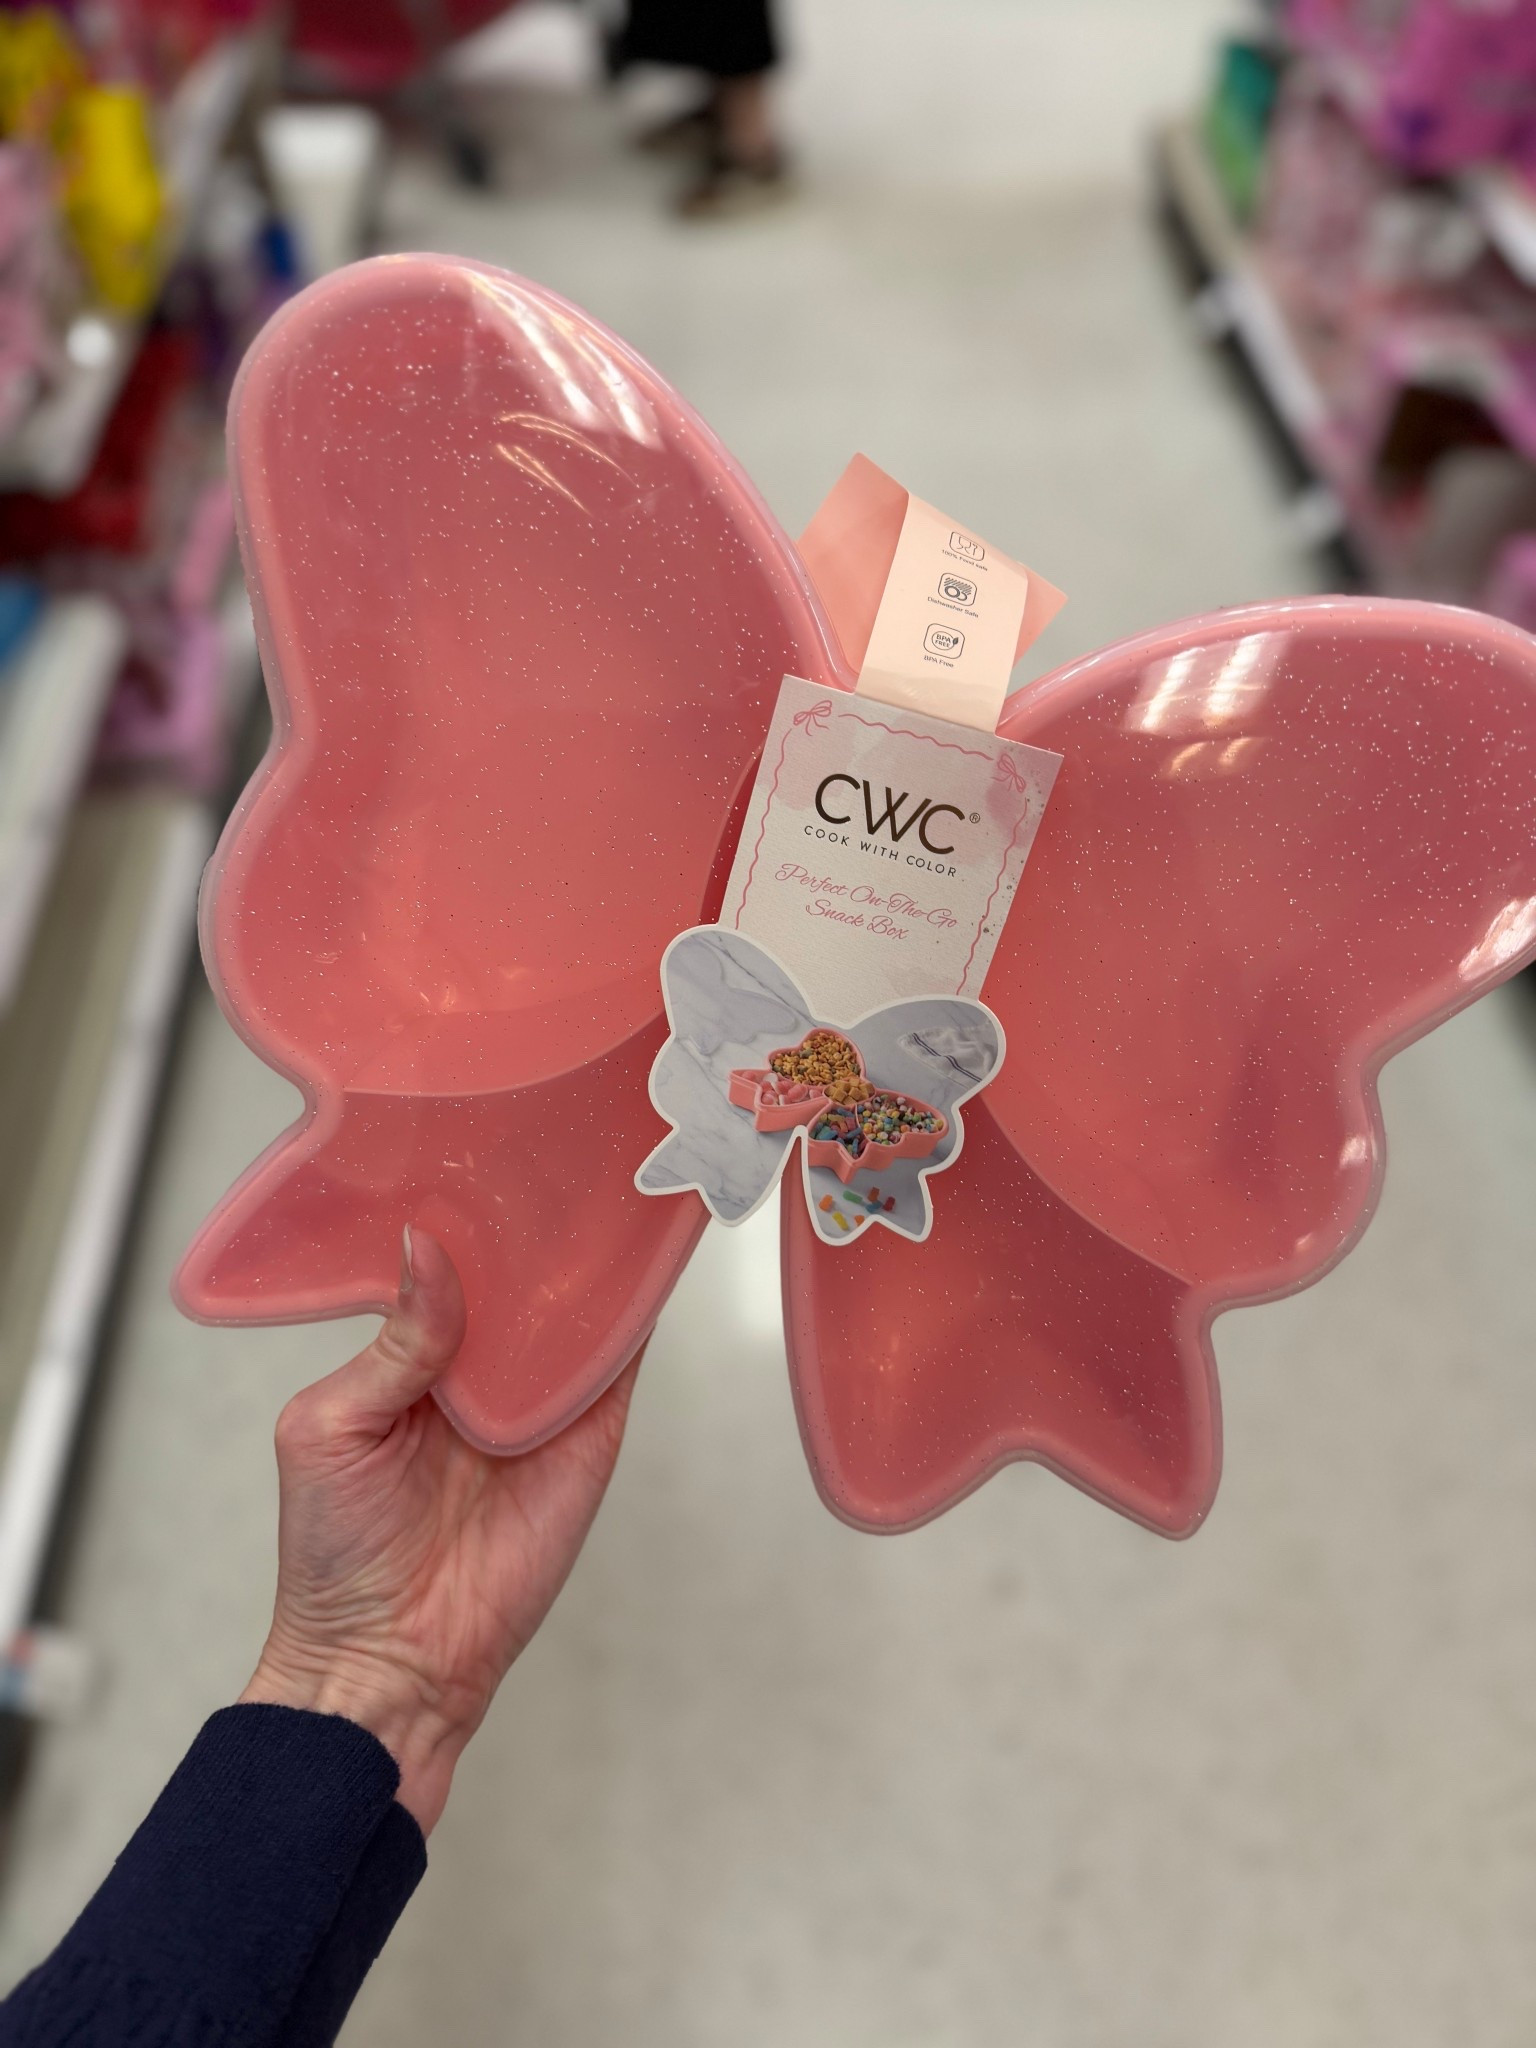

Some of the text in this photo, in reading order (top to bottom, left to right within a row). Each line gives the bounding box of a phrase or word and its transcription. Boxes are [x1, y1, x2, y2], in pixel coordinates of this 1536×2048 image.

[927, 596, 979, 618] Dishwasher Safe
[935, 639, 950, 648] FREE
[936, 633, 951, 643] BPA
[923, 654, 954, 668] BPA Free
[804, 825, 957, 878] COOK WITH COLOR
[775, 862, 958, 929] Perfect On-The-Go
[805, 899, 908, 941] Snack Box
